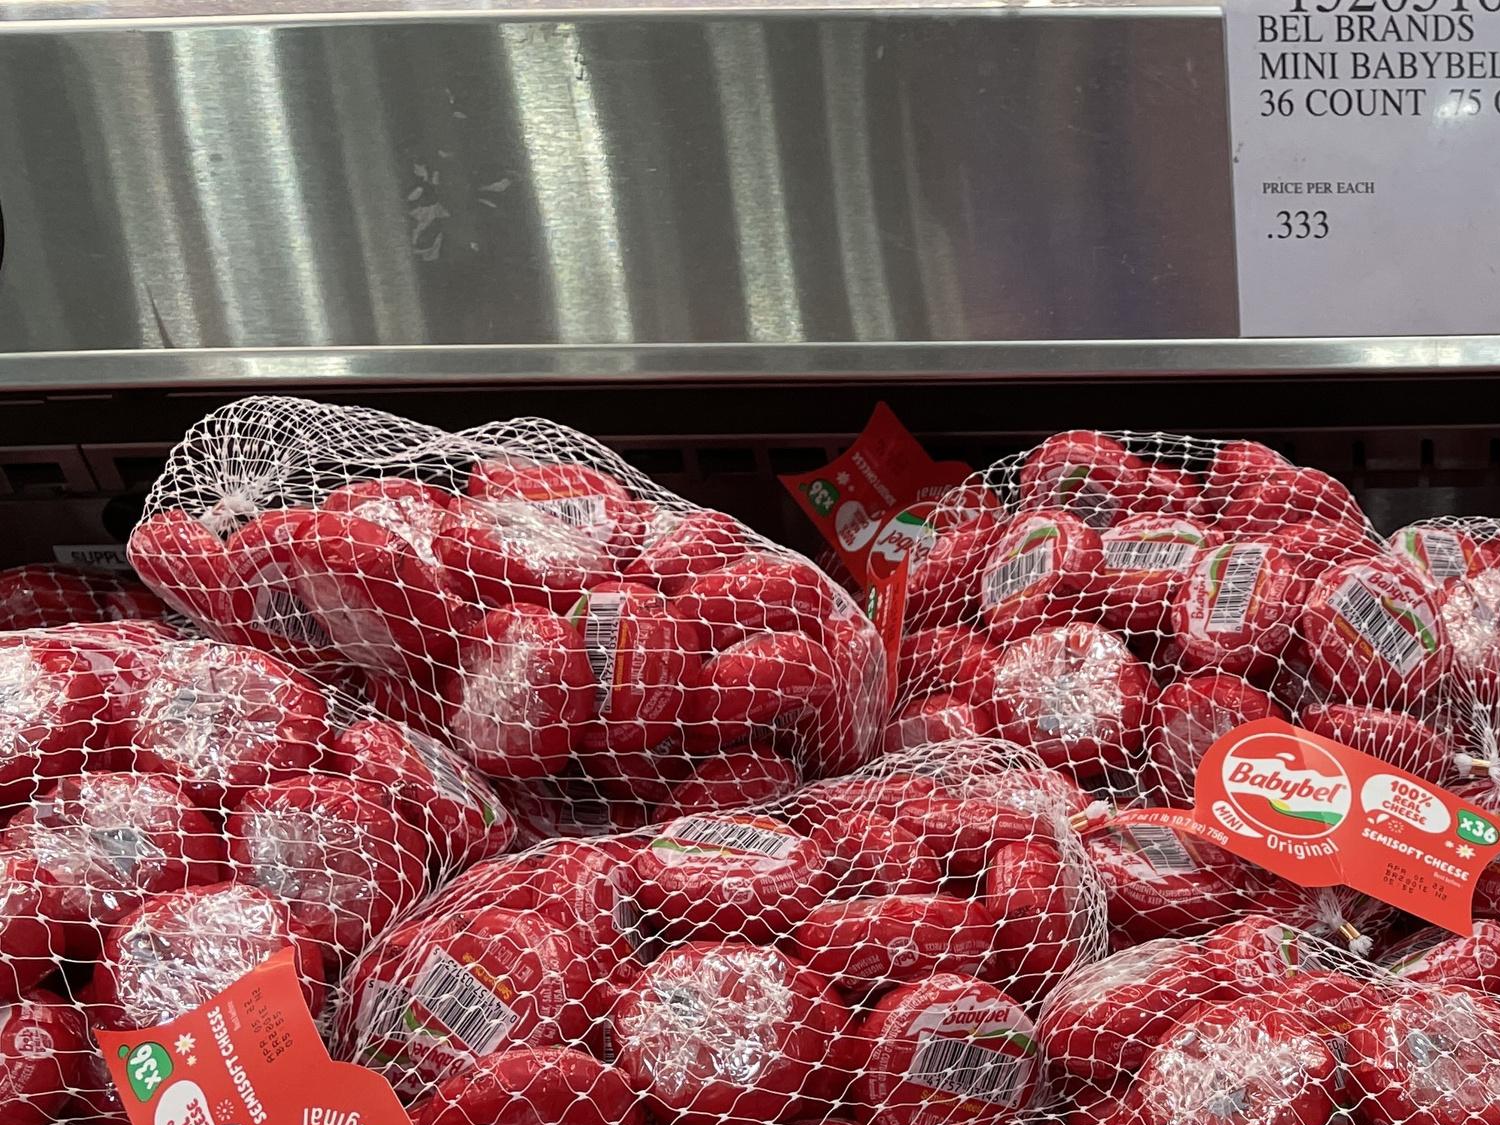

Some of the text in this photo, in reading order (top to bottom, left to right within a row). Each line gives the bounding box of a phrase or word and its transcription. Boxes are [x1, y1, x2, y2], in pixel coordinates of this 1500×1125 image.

[1258, 14, 1475, 43] BEL BRANDS
[1259, 52, 1339, 80] MINI
[1259, 88, 1294, 117] 36
[1305, 88, 1426, 117] COUNT
[1262, 180, 1375, 195] PRICE PER EACH
[1267, 210, 1330, 239] .333
[1229, 762, 1346, 804] Babybel
[1390, 780, 1433, 808] 100%
[1382, 799, 1429, 826] CHEESE
[1392, 795, 1422, 814] REAL
[1215, 805, 1244, 832] MINI
[1460, 818, 1498, 843] x36
[1207, 827, 1229, 845] 756g
[1267, 834, 1339, 860] Original
[1362, 828, 1470, 881] SEMISOFT CHEESE
[251, 1020, 262, 1032] 05
[510, 1015, 517, 1024] 0
[206, 1005, 267, 1125] SEMISOFT CHEESE
[260, 1041, 275, 1063] APR
[132, 1044, 162, 1090] x36
